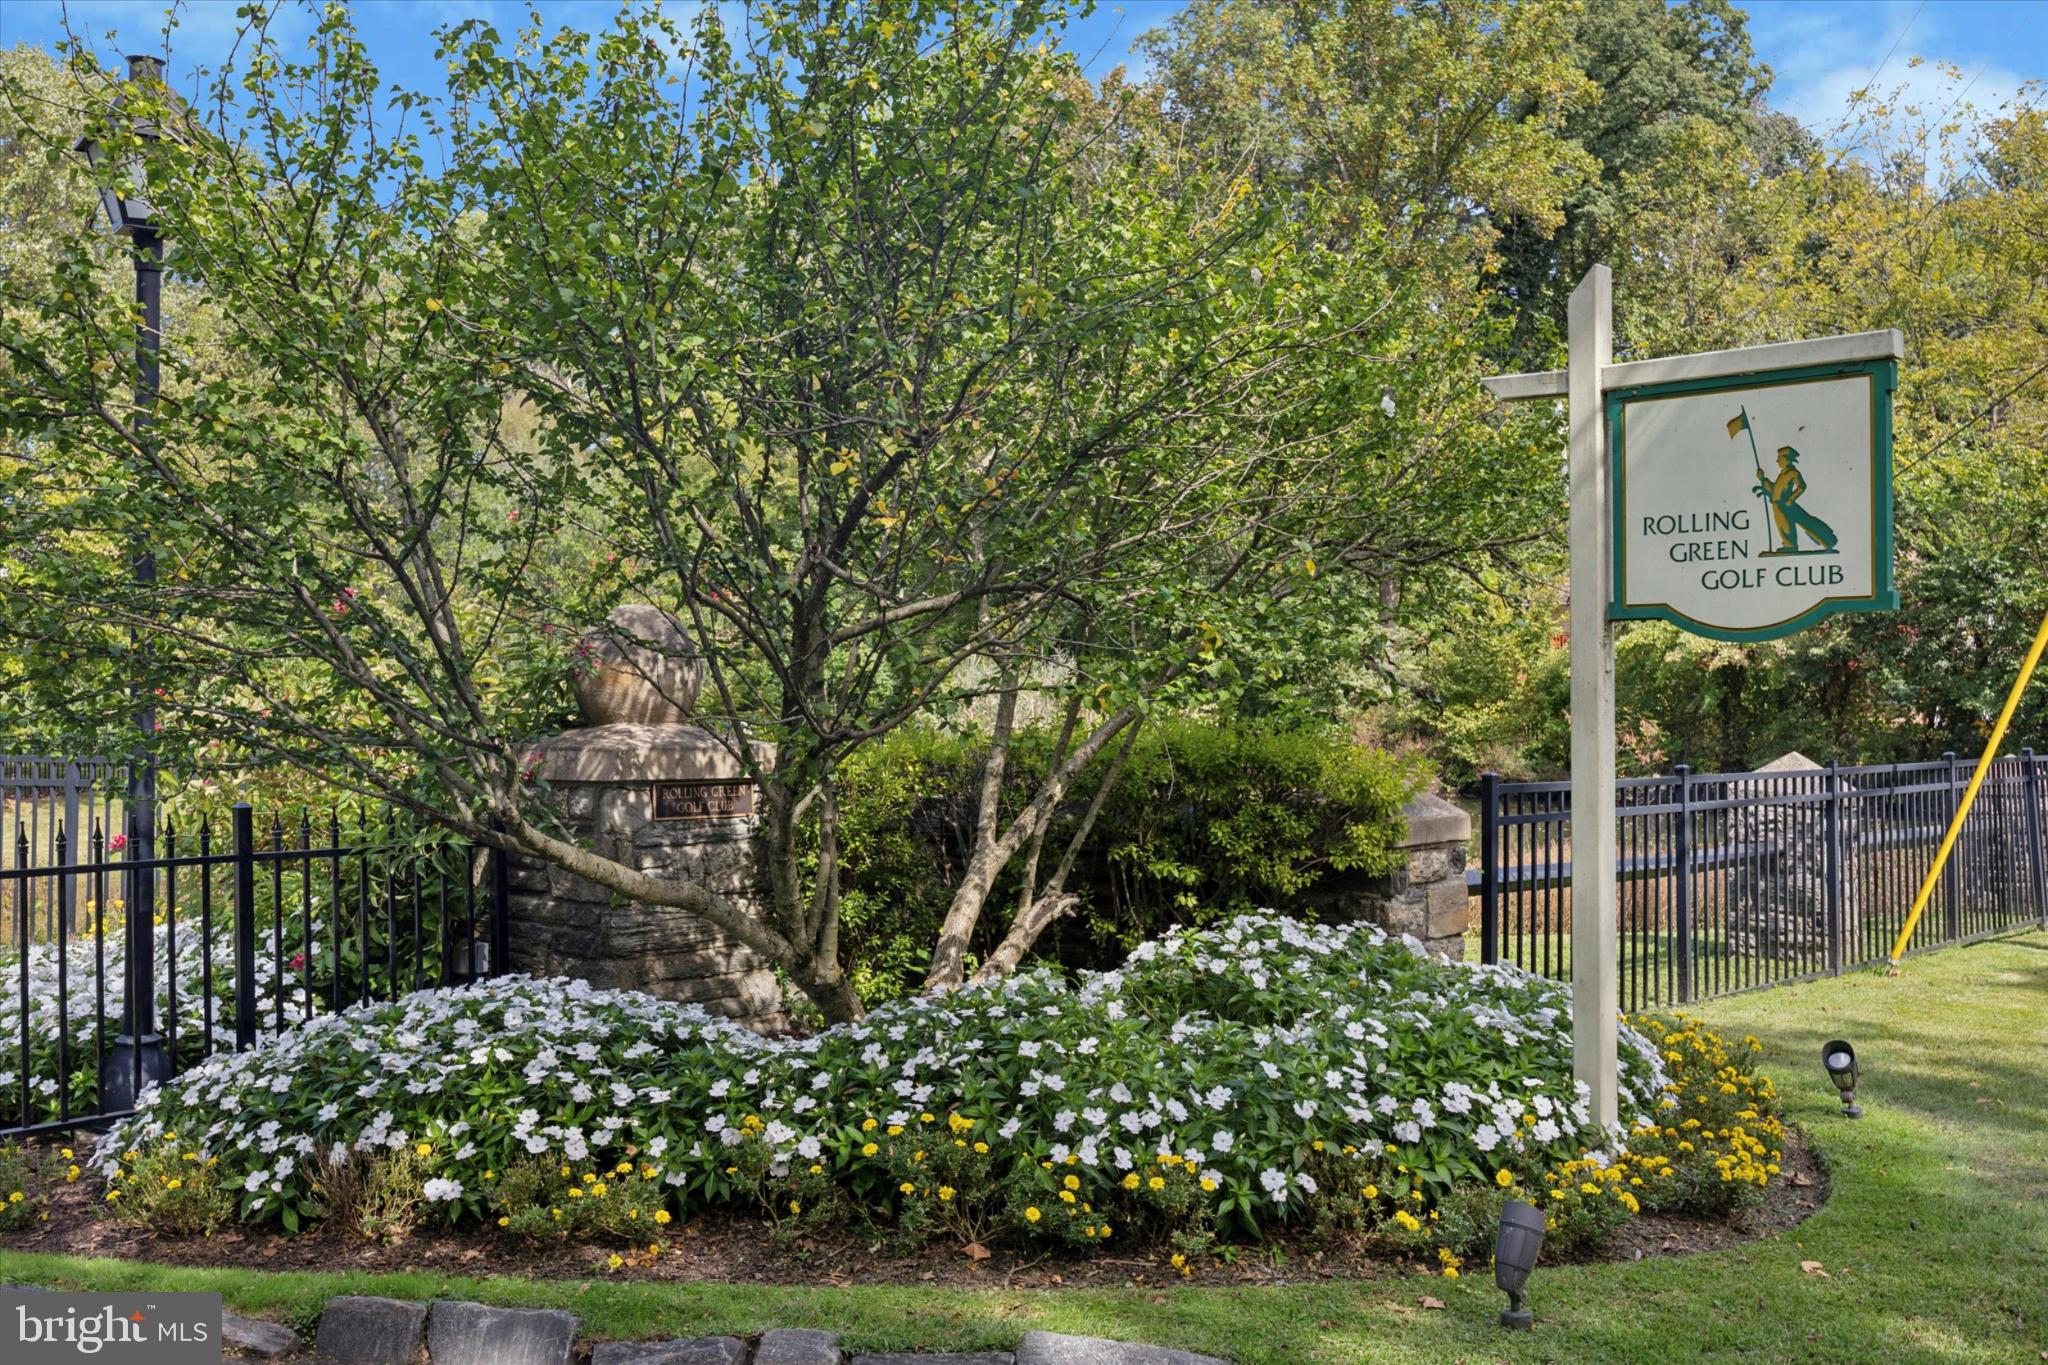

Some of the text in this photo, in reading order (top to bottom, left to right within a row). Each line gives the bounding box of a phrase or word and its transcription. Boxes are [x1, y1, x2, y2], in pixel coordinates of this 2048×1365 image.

[1643, 510, 1750, 536] ROLLING
[1669, 540, 1749, 562] GREEN
[1701, 565, 1844, 590] GOLF CLUB
[663, 785, 746, 800] ROLLING GREEN
[676, 800, 735, 813] GOLF CLUB
